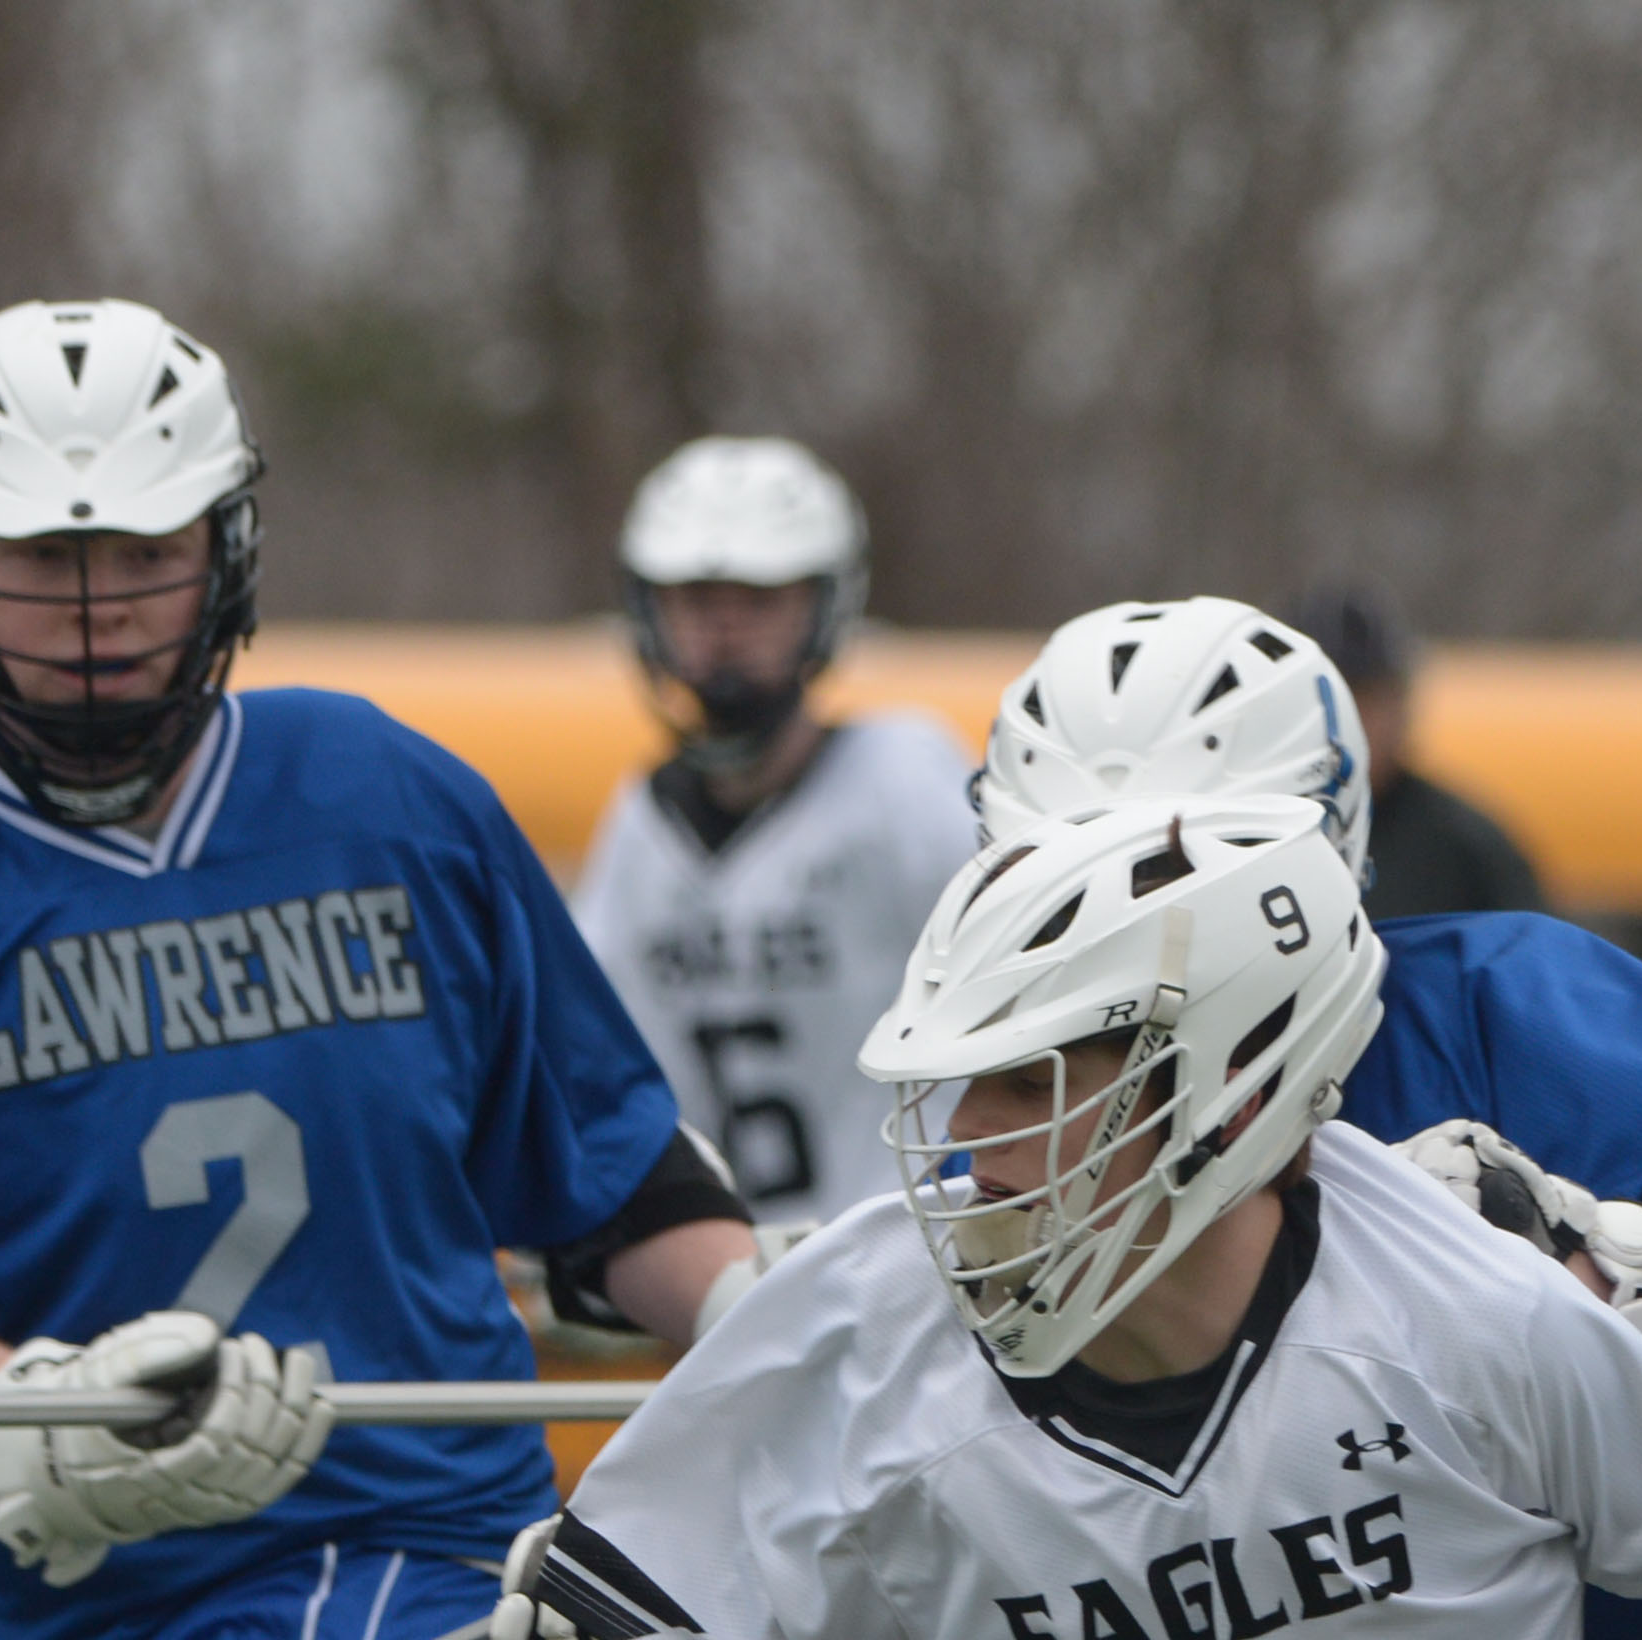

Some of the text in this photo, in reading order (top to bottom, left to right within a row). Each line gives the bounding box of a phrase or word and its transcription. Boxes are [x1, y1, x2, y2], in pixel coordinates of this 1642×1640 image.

[1259, 884, 1311, 955] 9
[1095, 1000, 1138, 1028] R
[692, 1018, 813, 1199] 6
[140, 1091, 332, 1381] 2
